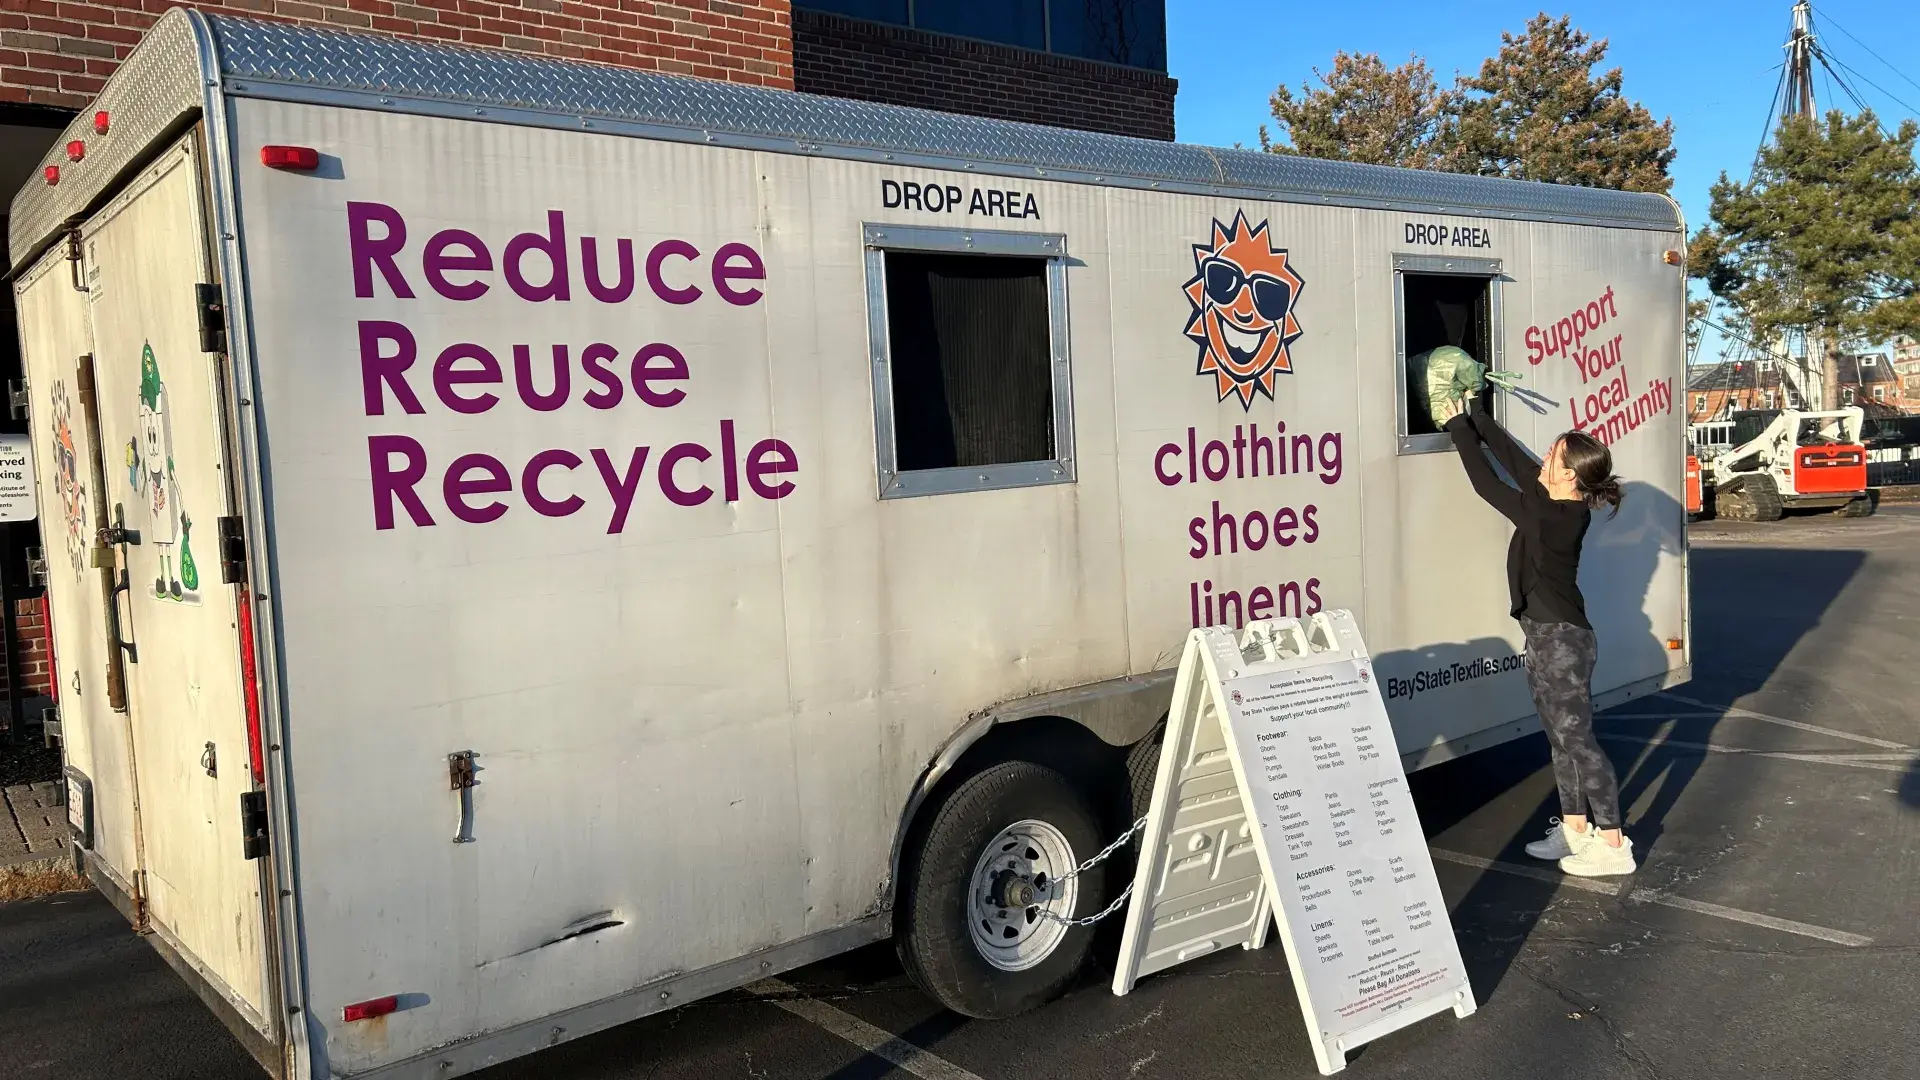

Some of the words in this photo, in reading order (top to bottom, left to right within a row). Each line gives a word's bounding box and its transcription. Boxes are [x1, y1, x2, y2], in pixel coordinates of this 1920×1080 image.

[881, 179, 963, 214] DROP
[968, 188, 1041, 220] AREA
[1404, 222, 1449, 246] DROP
[1451, 226, 1492, 249] AREA
[346, 201, 765, 306] Reduce
[1524, 284, 1618, 366] Support
[1571, 333, 1622, 384] Your
[357, 320, 690, 416] Reuse
[1569, 364, 1630, 432] Local
[1589, 376, 1673, 448] mmunity
[1154, 421, 1343, 487] clothing
[367, 419, 799, 535] Recycle
[1188, 500, 1320, 559] shoes
[1190, 577, 1323, 630] linens
[1269, 681, 1293, 689] Acceptable
[1311, 674, 1333, 682] Recycling
[1269, 712, 1292, 722] Support
[1292, 711, 1304, 719] your
[1304, 707, 1318, 715] local
[1256, 730, 1288, 742] Footwear:
[1259, 745, 1276, 753] Shoes
[1264, 763, 1283, 771] Pumps
[1267, 772, 1288, 781] Sandals
[1272, 788, 1303, 800] Clothing:
[1369, 790, 1383, 798] Socks
[1278, 811, 1301, 821] Sweaters
[1281, 820, 1309, 831] Sweatshirts
[1284, 831, 1304, 841] Dresses
[1334, 829, 1350, 838] Shorts
[1287, 842, 1300, 851] Tank
[1289, 851, 1308, 861] Blazers
[1296, 864, 1336, 881] Accessories:
[1346, 868, 1362, 877] Gloves
[1362, 875, 1374, 883] Bags
[1301, 888, 1331, 902] Pocketbooks
[1419, 909, 1432, 917] Rugs
[1310, 918, 1334, 932] Linens:
[1364, 927, 1381, 936] Towels
[1314, 933, 1331, 943] Sheets
[1367, 937, 1381, 946] Table
[1317, 942, 1338, 953] Blankets
[1359, 974, 1377, 985] Reduce
[1397, 960, 1415, 971] Recycle
[1358, 984, 1376, 996] Please
[1376, 980, 1387, 989] Bag
[1395, 967, 1420, 982] Donations
